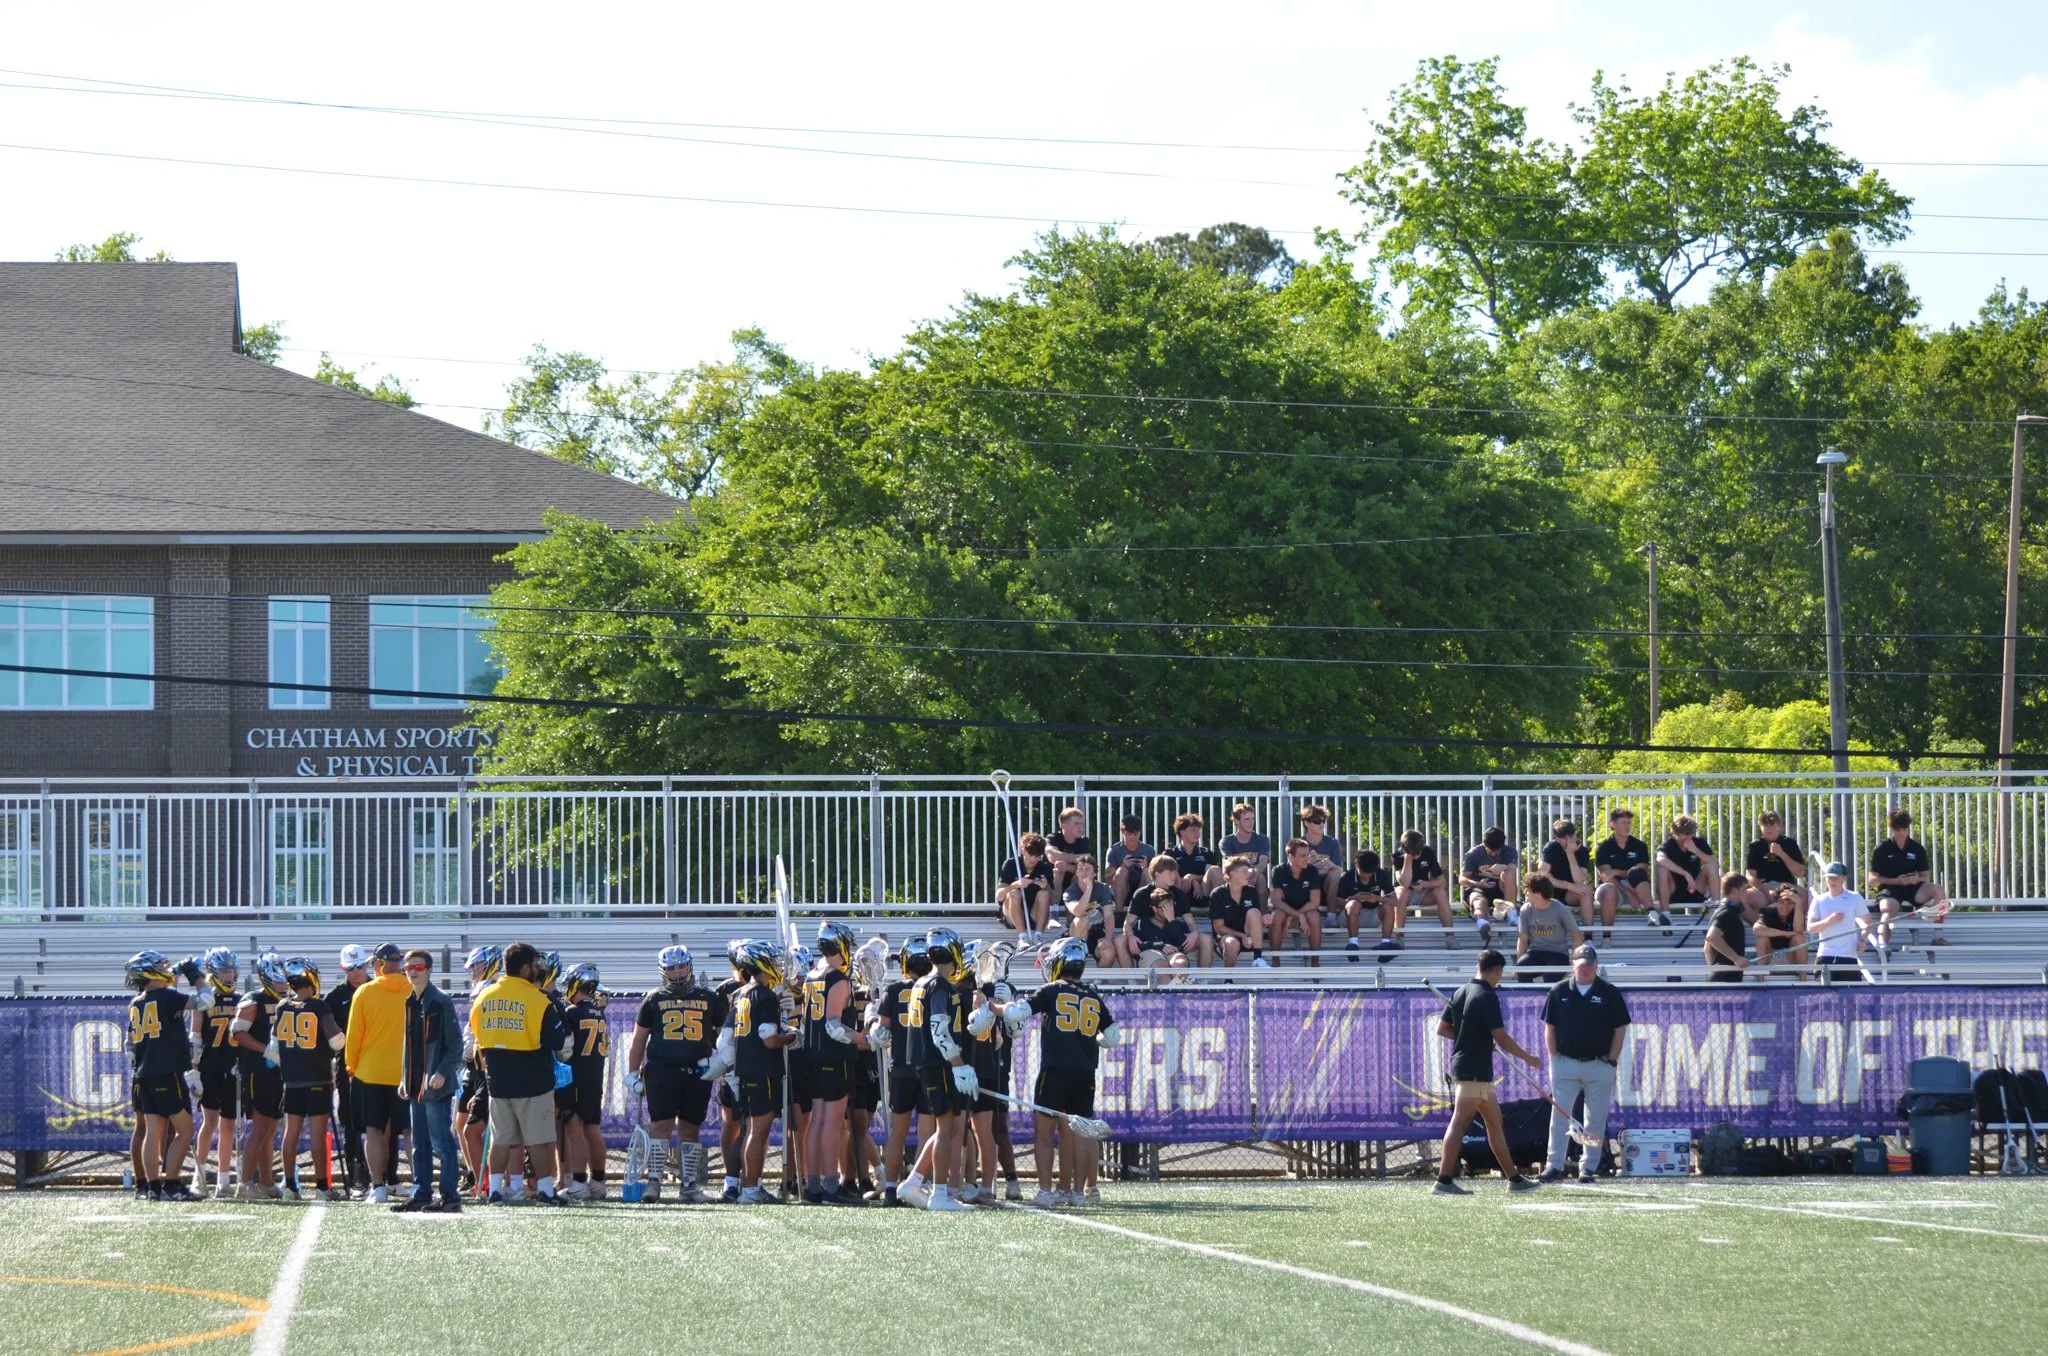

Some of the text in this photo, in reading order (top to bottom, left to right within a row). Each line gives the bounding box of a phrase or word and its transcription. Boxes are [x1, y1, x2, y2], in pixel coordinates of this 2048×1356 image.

[247, 728, 386, 748] CHATHAM
[296, 756, 319, 776] &
[326, 756, 455, 776] PHYSICAL
[129, 1000, 162, 1044] 34
[482, 998, 525, 1016] WILDCATS
[1056, 993, 1101, 1036] 56
[276, 1010, 319, 1050] 49
[662, 1010, 703, 1040] 25
[1614, 1021, 1778, 1108] OME
[1798, 1019, 1893, 1105] OF
